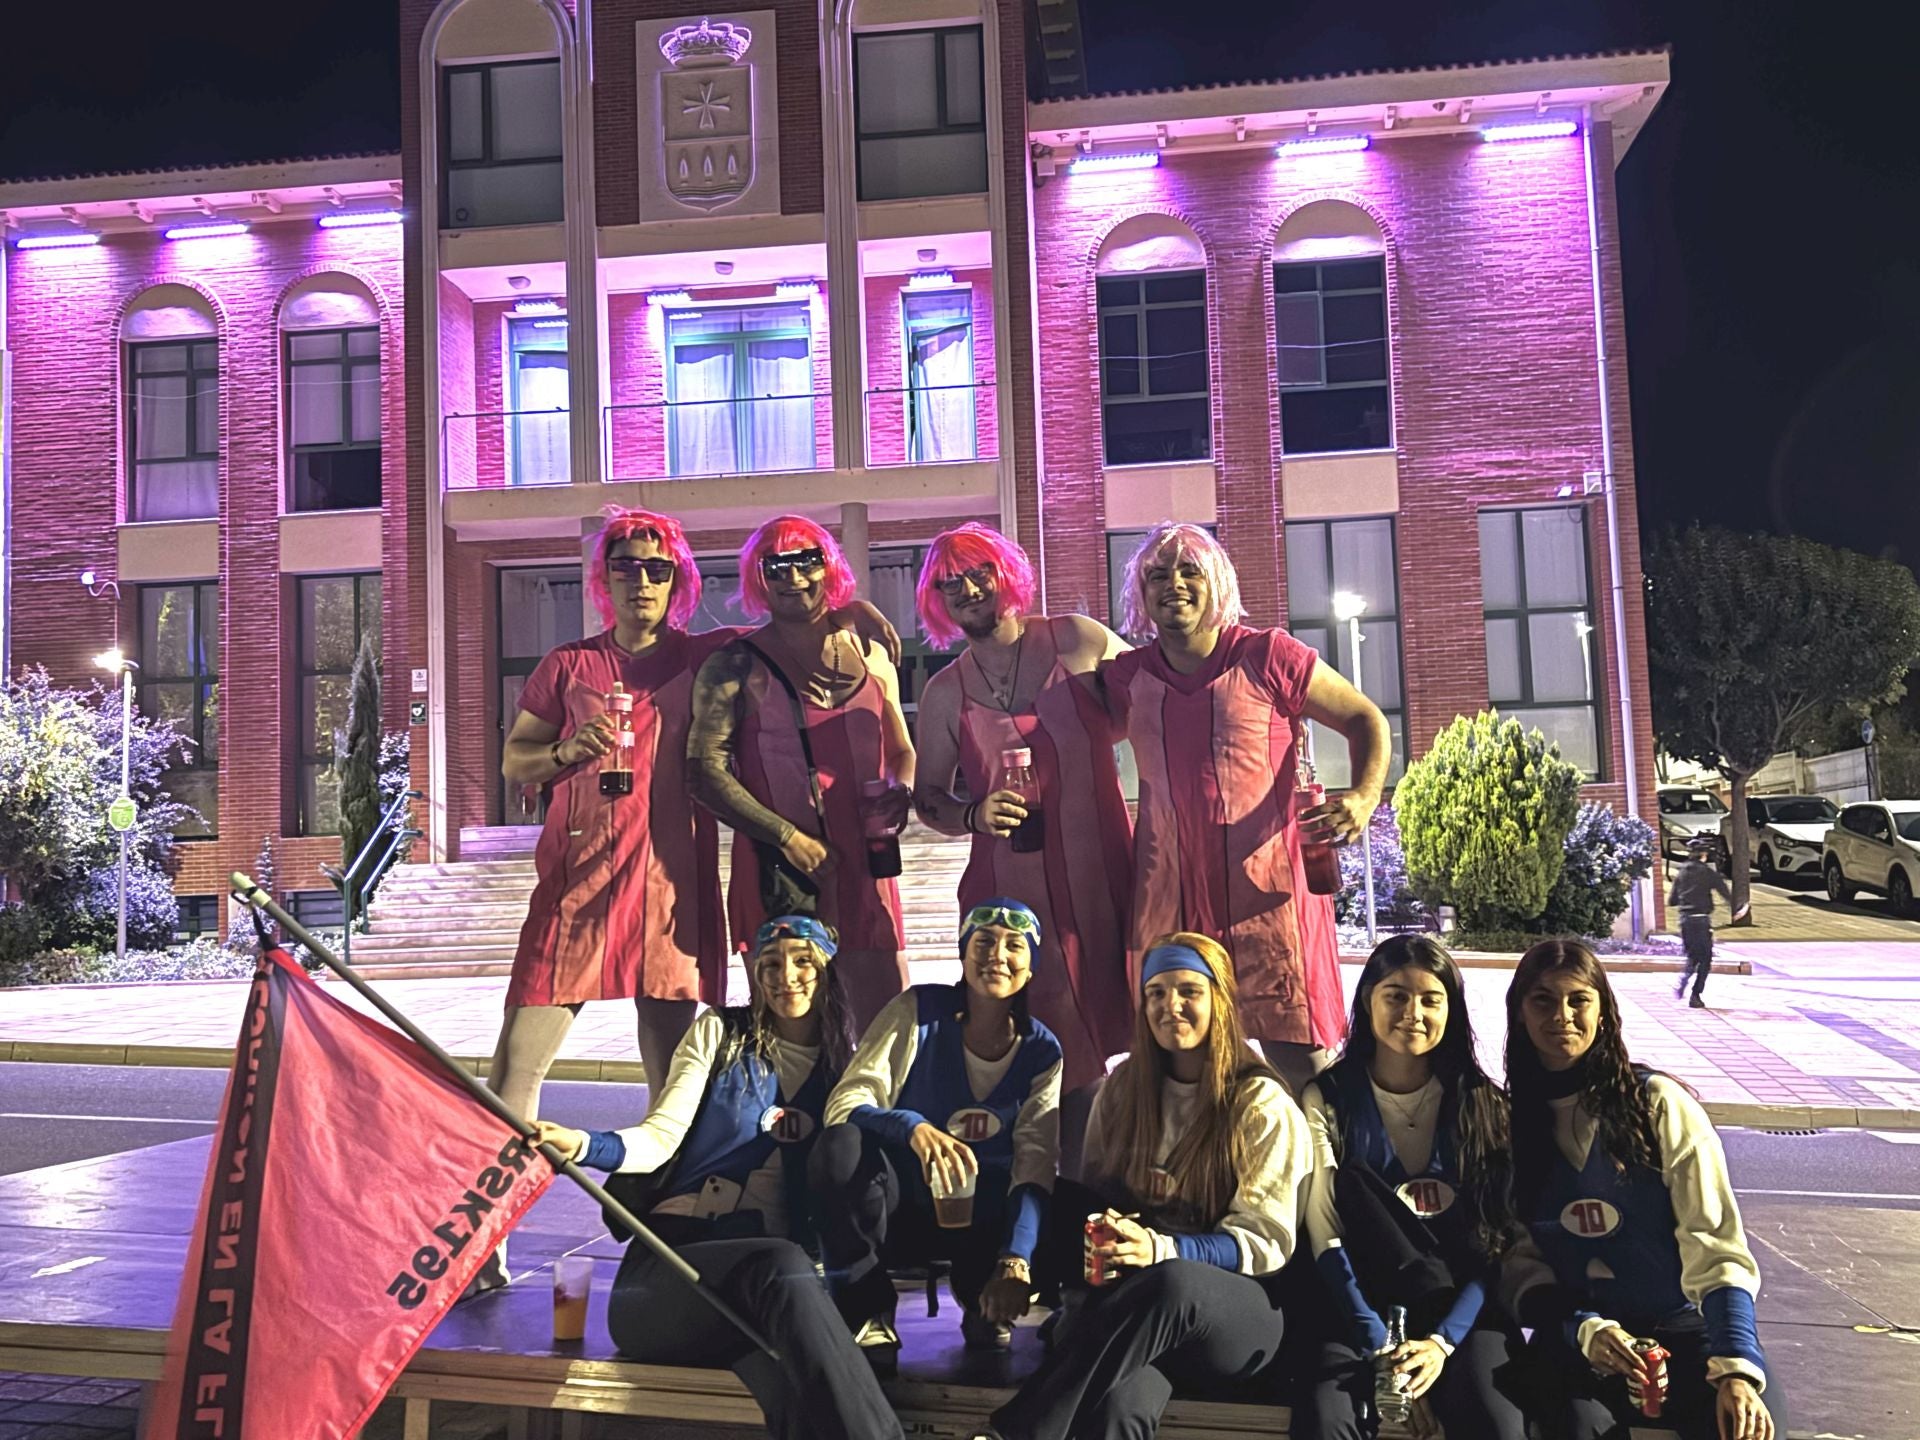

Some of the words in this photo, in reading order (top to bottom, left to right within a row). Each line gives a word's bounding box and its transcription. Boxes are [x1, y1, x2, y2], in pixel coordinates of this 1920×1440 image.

[773, 1110, 800, 1139] 10
[959, 1112, 989, 1140] 10
[1405, 1182, 1442, 1212] 10
[1570, 1202, 1607, 1234] 10
